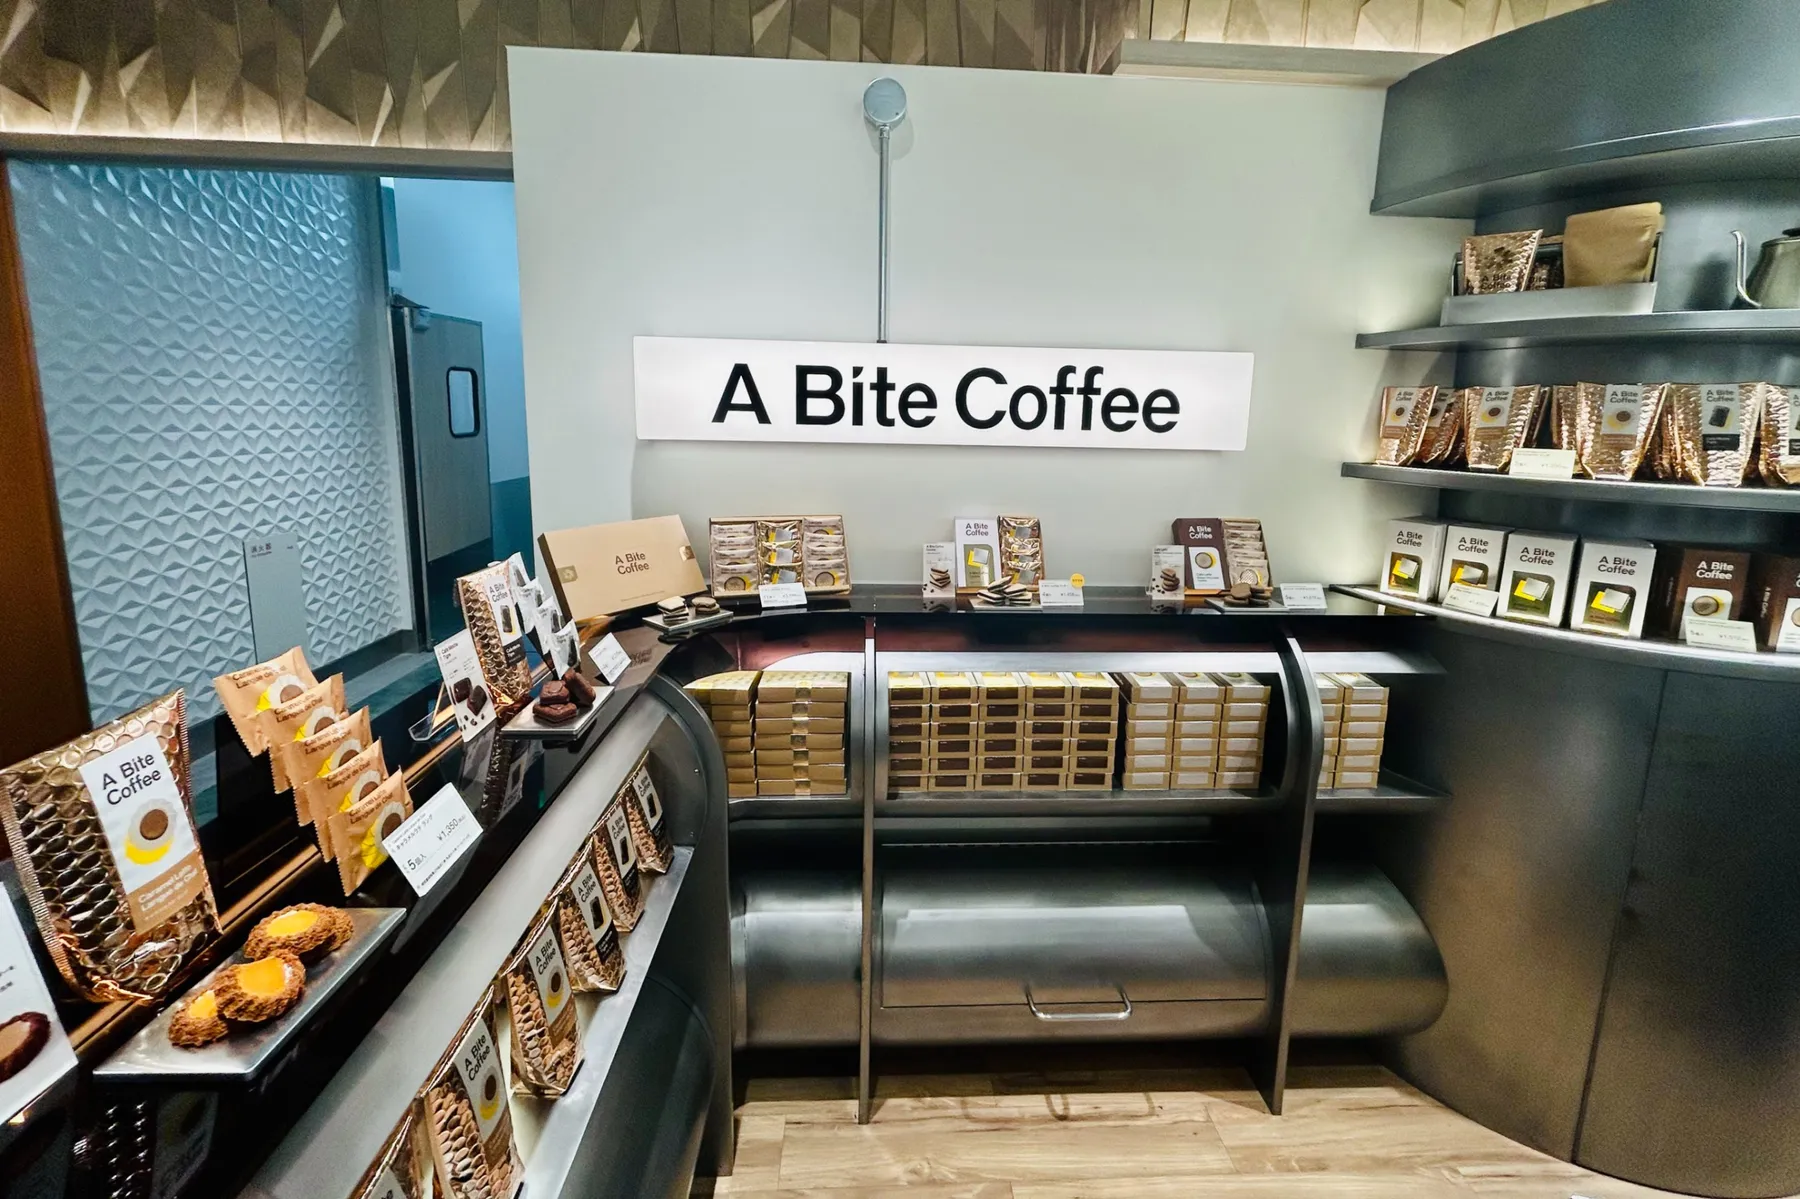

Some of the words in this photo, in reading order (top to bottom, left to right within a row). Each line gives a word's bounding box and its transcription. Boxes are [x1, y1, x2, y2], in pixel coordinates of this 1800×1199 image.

[711, 363, 772, 424] A
[795, 364, 938, 428] Bite
[955, 364, 1181, 434] Coffee
[1189, 532, 1213, 540] Coffee
[1397, 538, 1422, 547] Coffee
[1406, 532, 1423, 540] Bite
[1470, 538, 1489, 546] Bite
[1458, 544, 1488, 554] Coffee
[1534, 548, 1555, 557] Bite
[615, 556, 624, 565] A
[625, 552, 646, 563] Bite
[1520, 555, 1554, 566] Coffee
[1599, 556, 1608, 564] A
[1613, 557, 1637, 567] Bite
[617, 562, 650, 575] Coffee
[1598, 565, 1635, 575] Coffee
[1698, 561, 1707, 569] A
[1711, 562, 1734, 571] Bite
[1696, 570, 1732, 580] Coffee
[102, 773, 116, 790] A
[120, 753, 155, 779] Bite
[107, 769, 162, 805] Coffee
[437, 818, 459, 841] ¥1,350
[578, 886, 584, 894] A
[582, 873, 593, 887] Bite
[580, 881, 596, 902] Coffee
[535, 956, 542, 966] A
[540, 938, 553, 957] Bite
[538, 948, 556, 975] Coffee
[464, 1058, 472, 1071] A
[471, 1034, 487, 1057] Bite
[468, 1045, 491, 1081] Coffee
